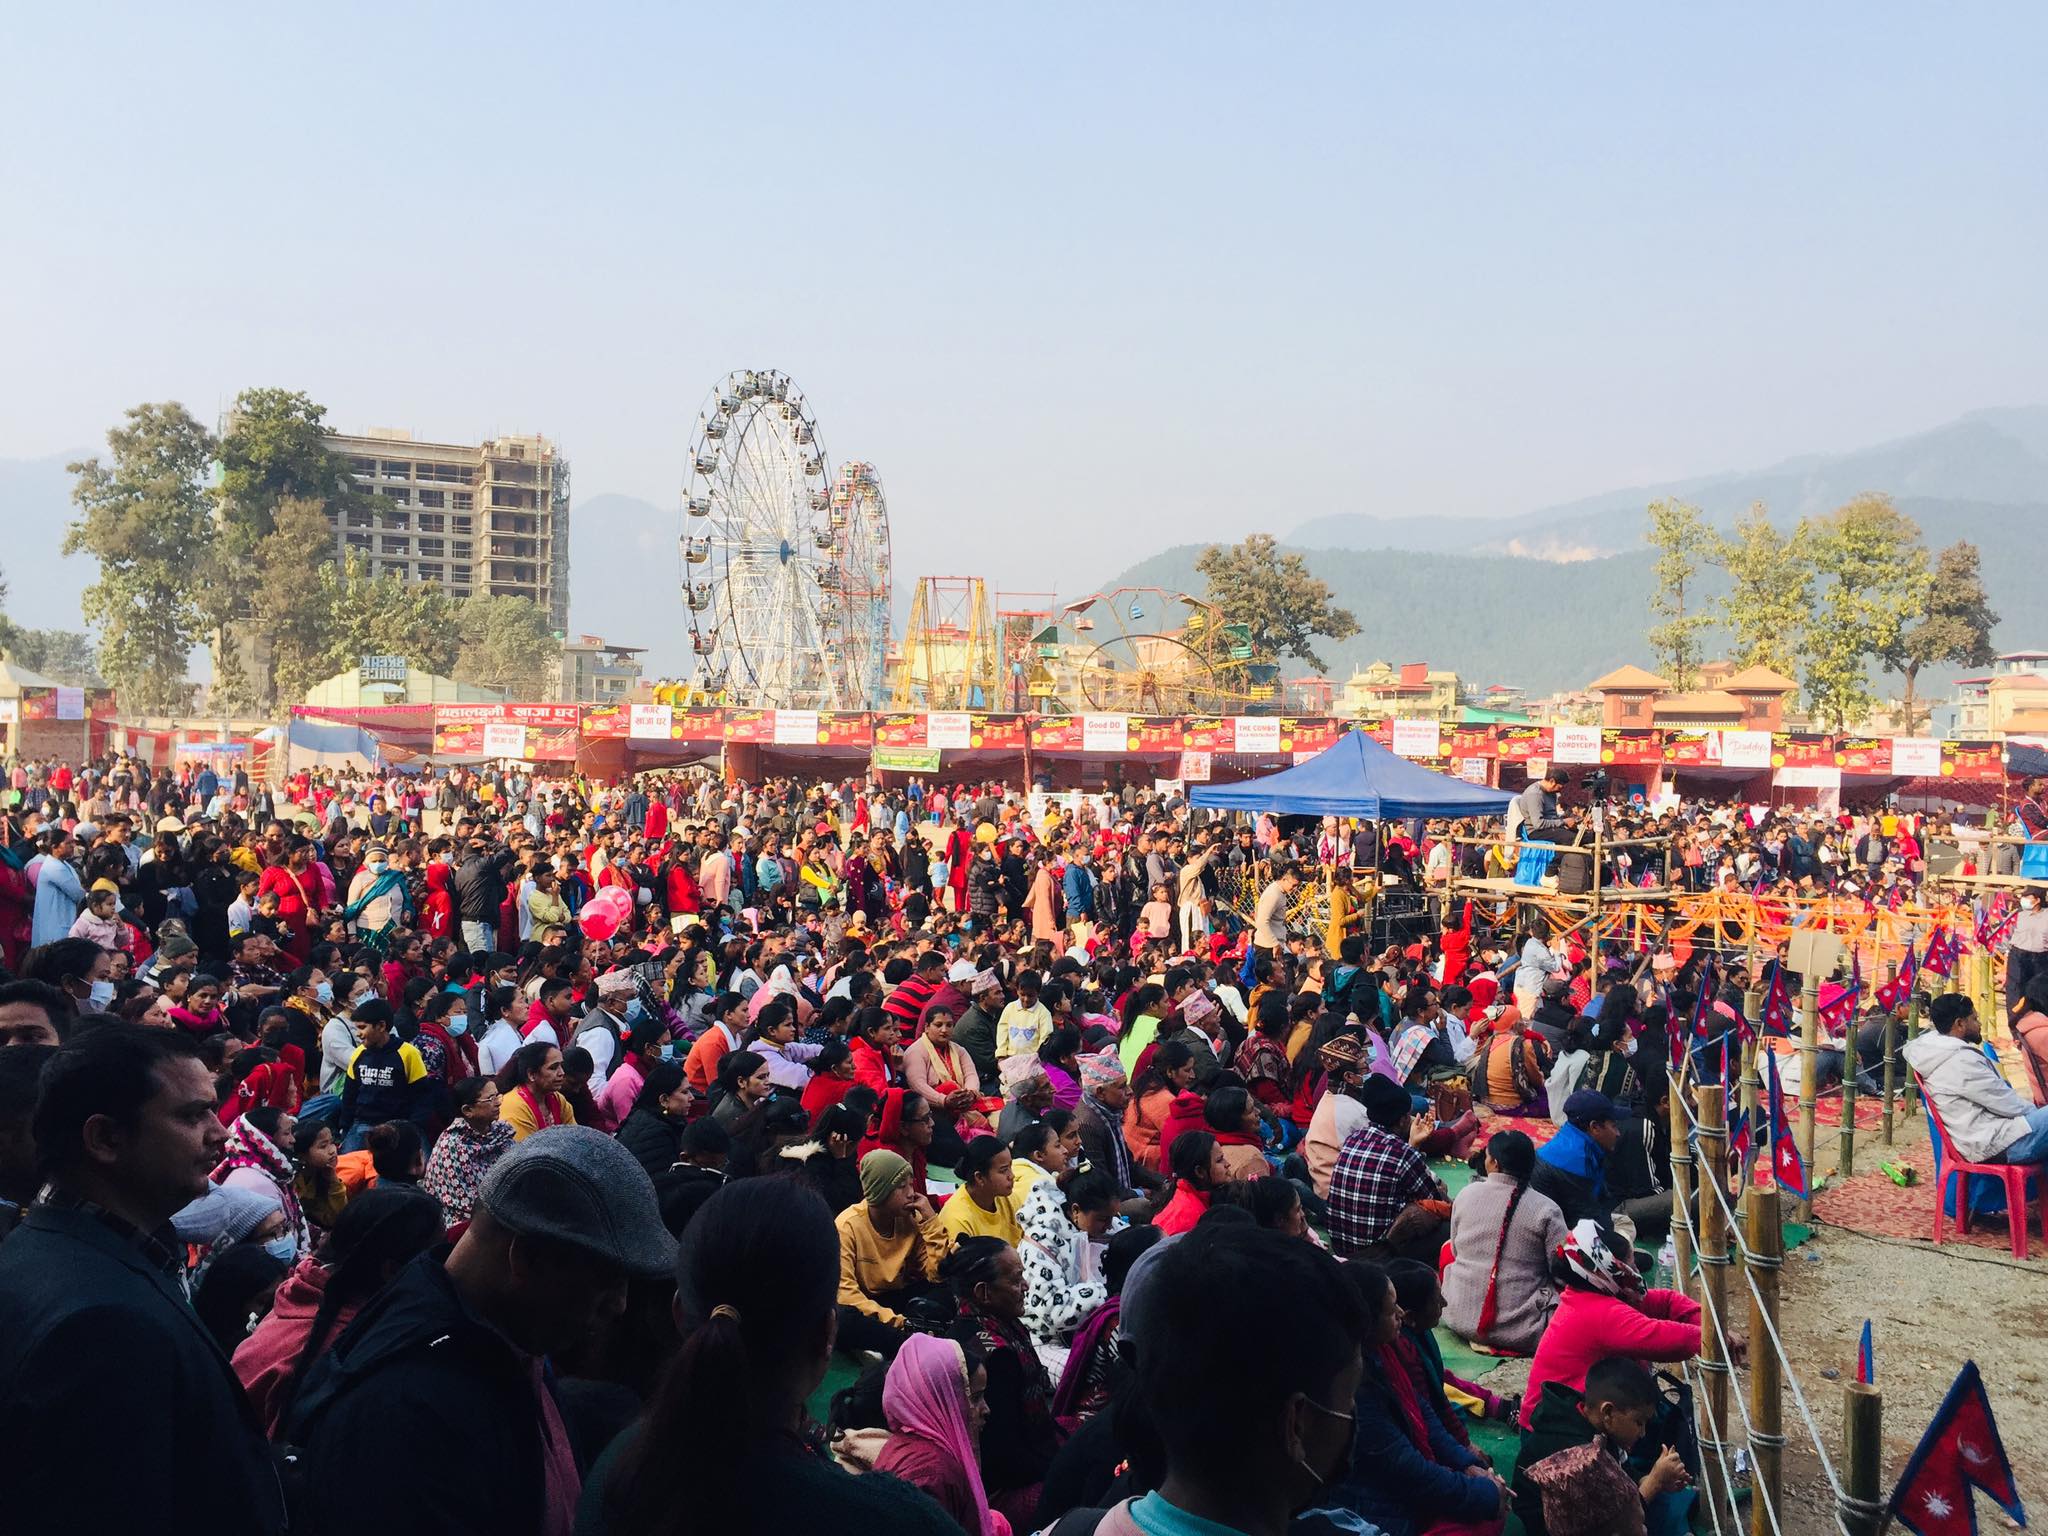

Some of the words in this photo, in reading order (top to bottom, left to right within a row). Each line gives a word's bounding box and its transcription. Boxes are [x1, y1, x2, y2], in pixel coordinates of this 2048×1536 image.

[512, 707, 551, 718] खाजा
[554, 708, 577, 718] घर
[1088, 720, 1107, 729] Good
